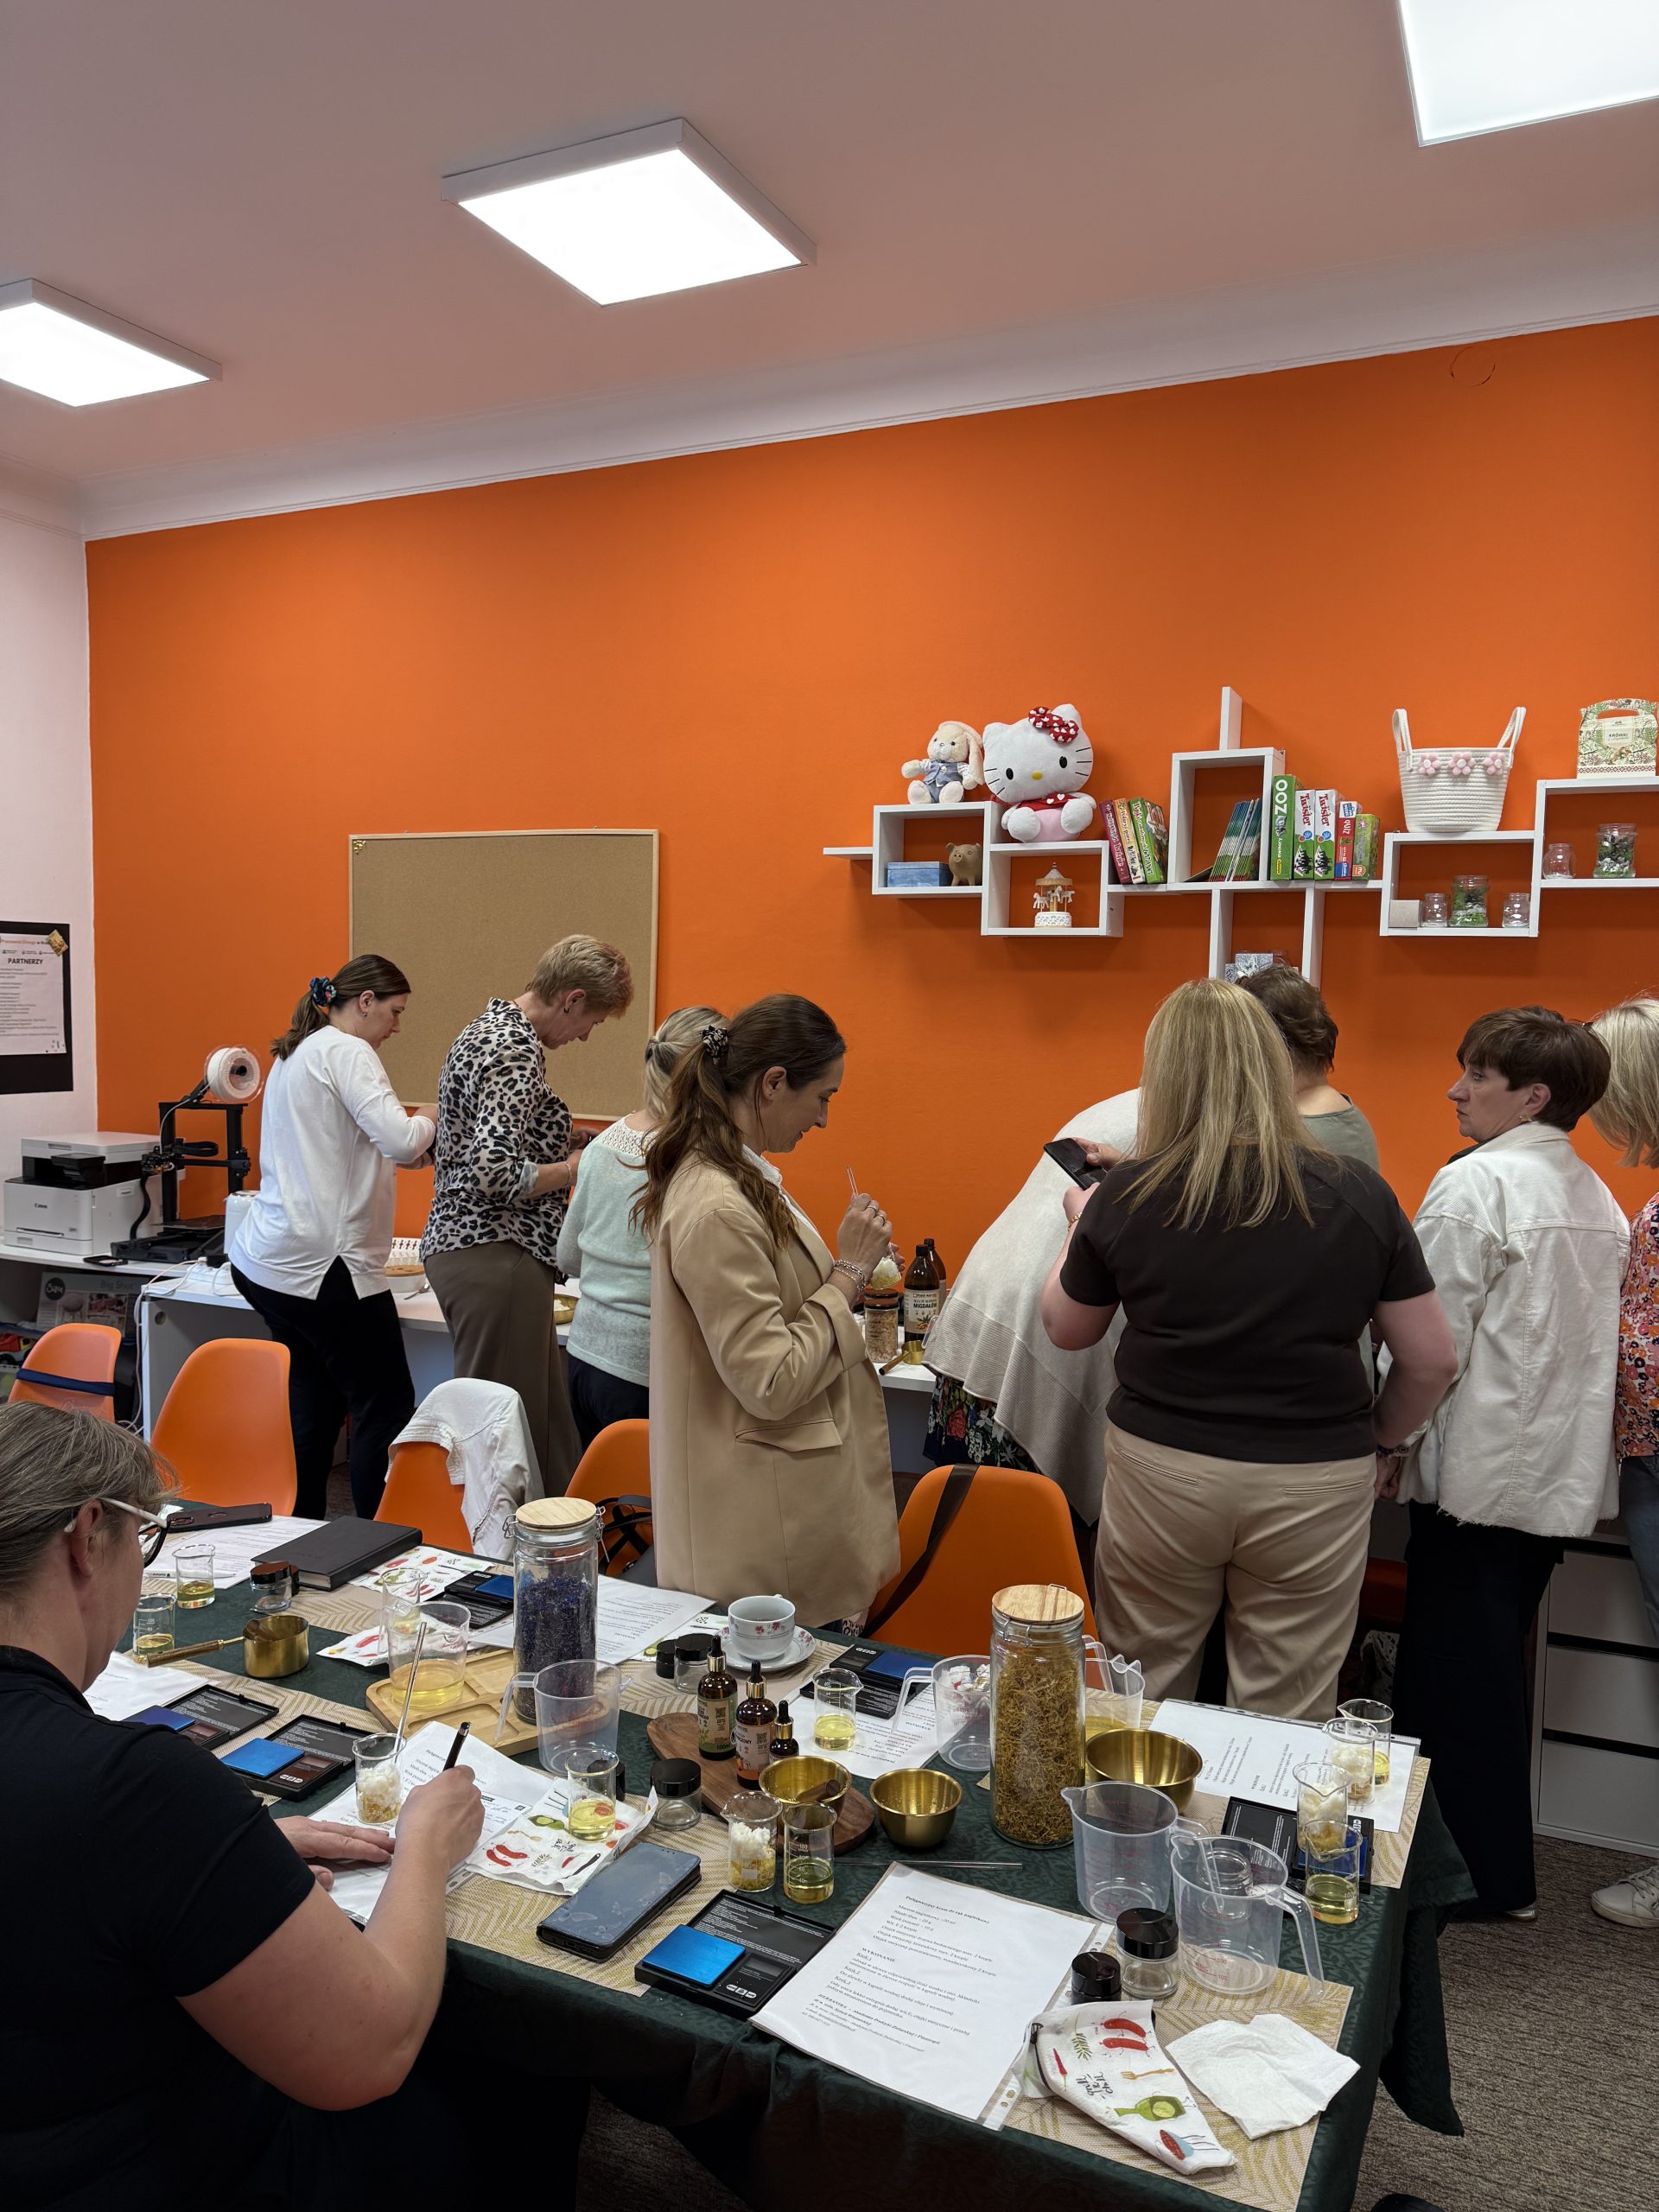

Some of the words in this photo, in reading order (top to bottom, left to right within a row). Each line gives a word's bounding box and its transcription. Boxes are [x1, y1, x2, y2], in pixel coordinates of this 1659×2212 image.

[1274, 779, 1288, 816] ZOO
[1300, 792, 1312, 826] Twister
[1319, 792, 1331, 827] Twister
[1342, 819, 1351, 835] QUIZ
